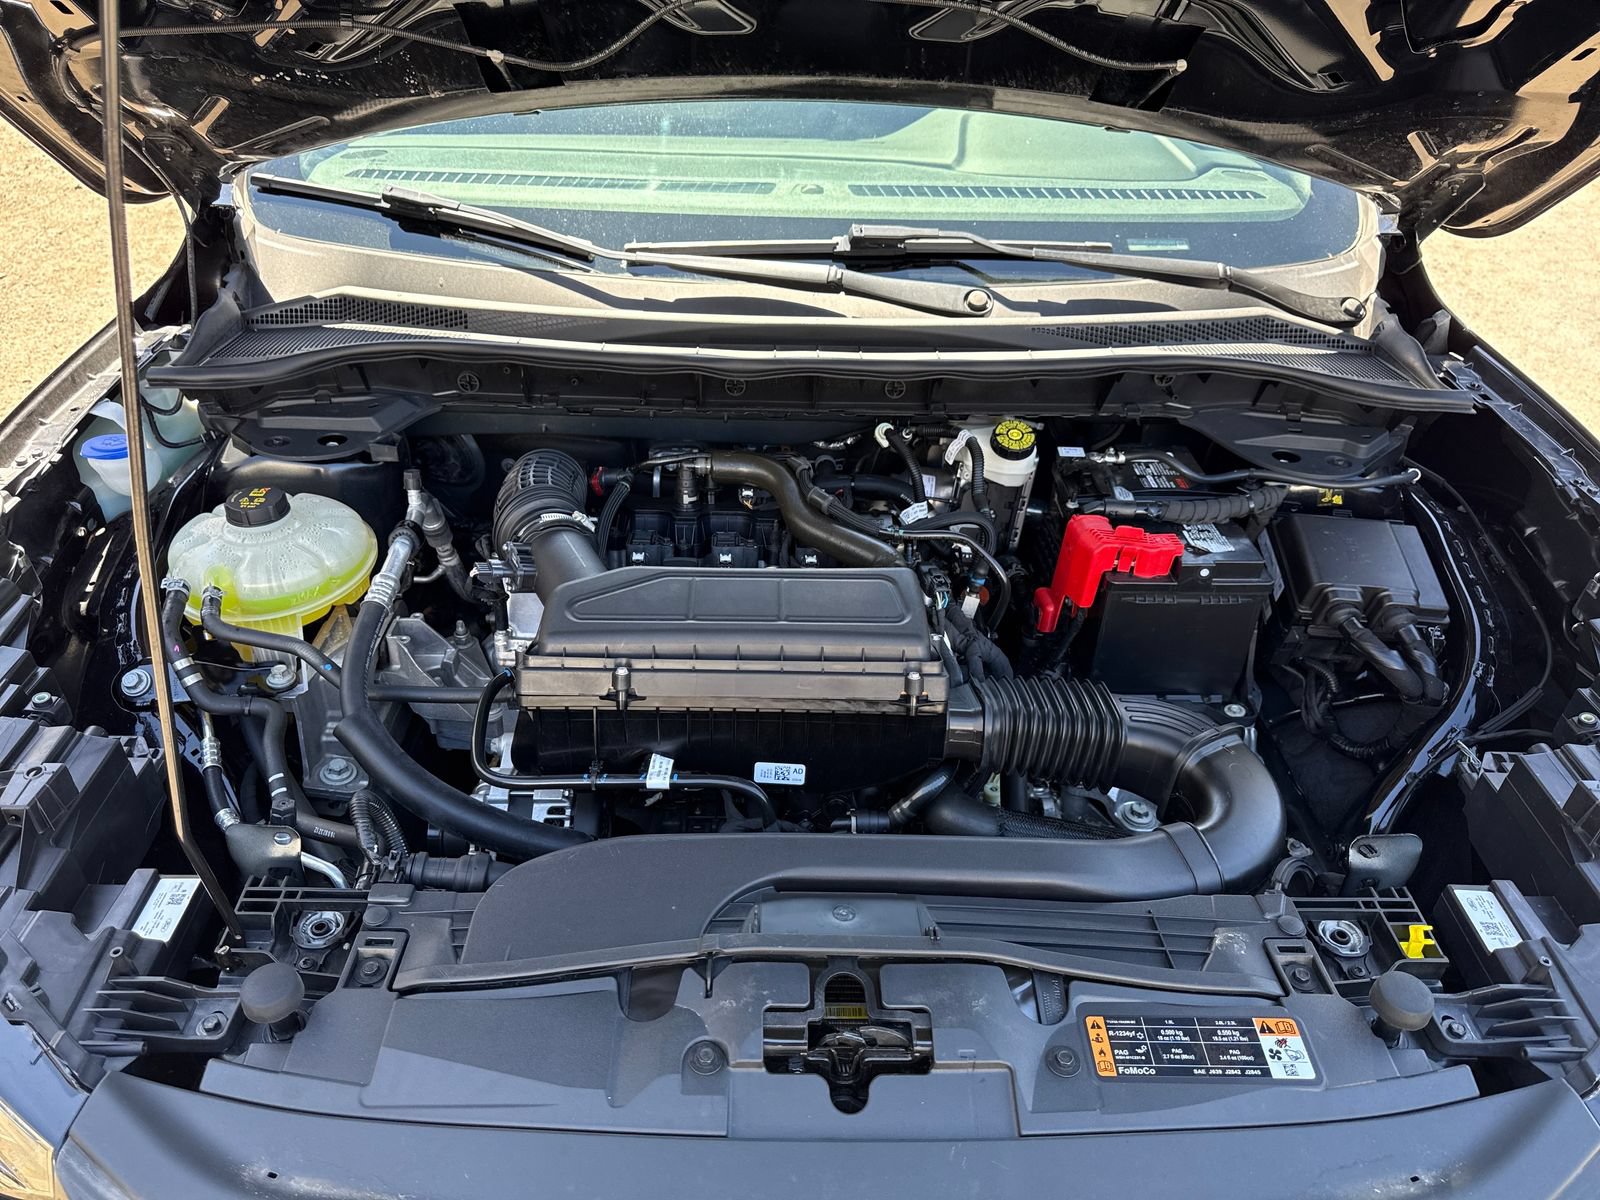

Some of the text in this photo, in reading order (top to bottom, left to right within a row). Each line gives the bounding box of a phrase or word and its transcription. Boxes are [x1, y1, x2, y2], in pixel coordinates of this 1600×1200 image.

[1108, 1030, 1136, 1038] R-1234yf
[1175, 1029, 1184, 1037] kg
[1231, 1029, 1240, 1037] kg
[1118, 1067, 1156, 1075] FoMoCo
